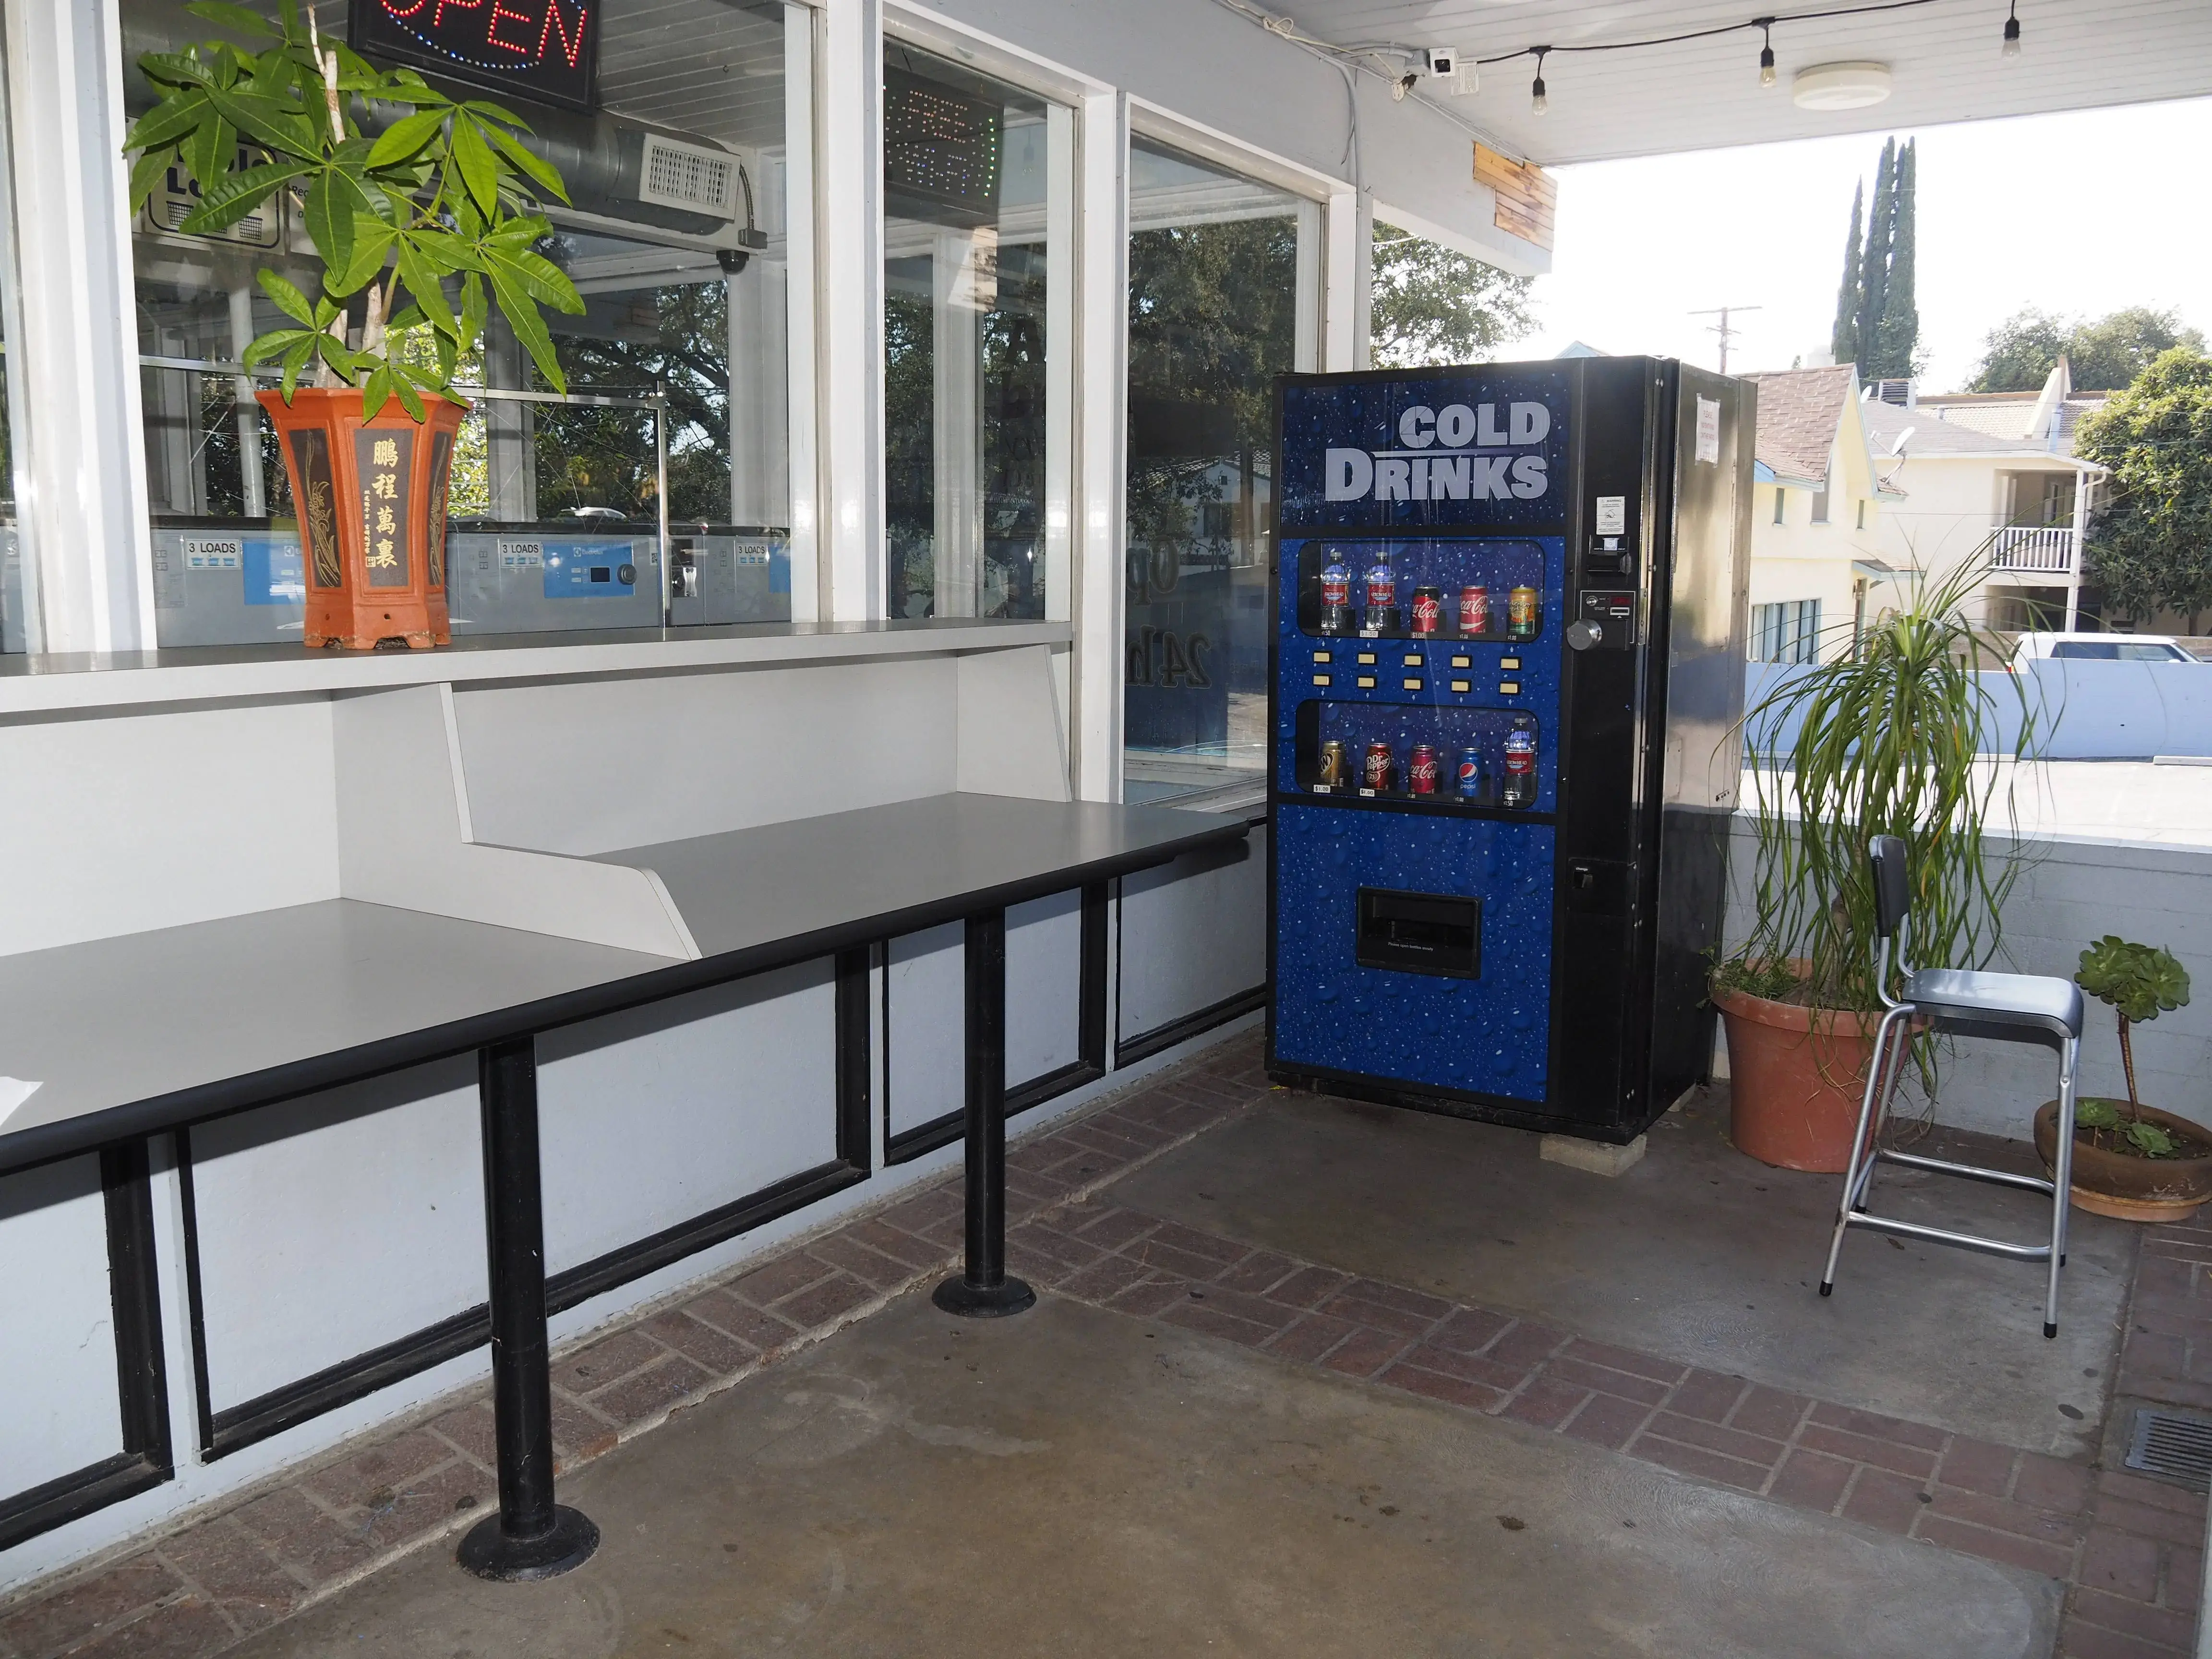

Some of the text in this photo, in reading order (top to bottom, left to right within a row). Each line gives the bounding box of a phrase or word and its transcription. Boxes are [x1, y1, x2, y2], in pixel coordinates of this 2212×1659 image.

[380, 0, 587, 67] EN
[1399, 402, 1550, 448] COLD
[1325, 448, 1548, 501] DRINKS
[189, 543, 236, 553] 3 LOADS
[503, 544, 539, 553] 3 LOADS
